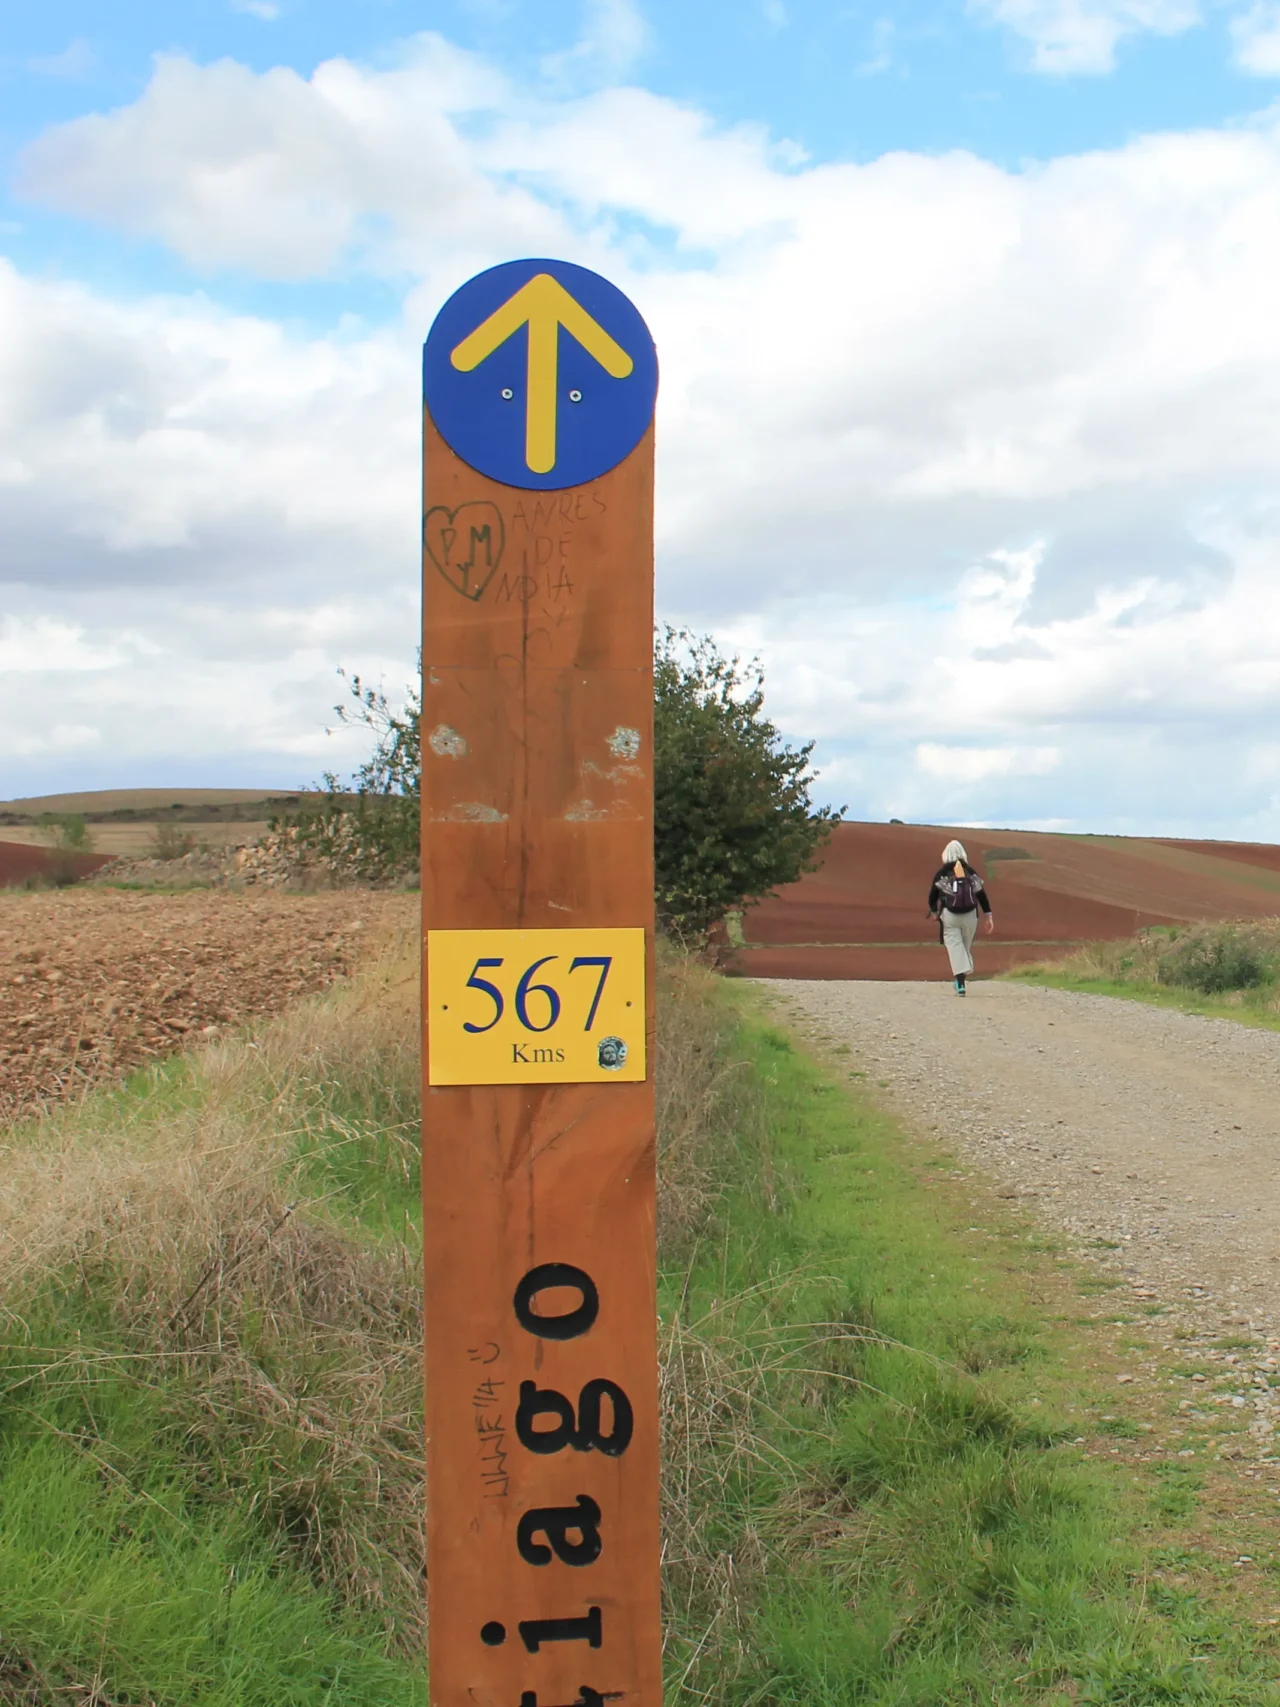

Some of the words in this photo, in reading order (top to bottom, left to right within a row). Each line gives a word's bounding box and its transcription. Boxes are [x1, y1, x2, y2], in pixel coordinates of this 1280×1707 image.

[468, 523, 492, 567] M
[462, 955, 613, 1034] 567
[511, 1043, 565, 1064] Kms
[480, 1261, 634, 1707] iago
